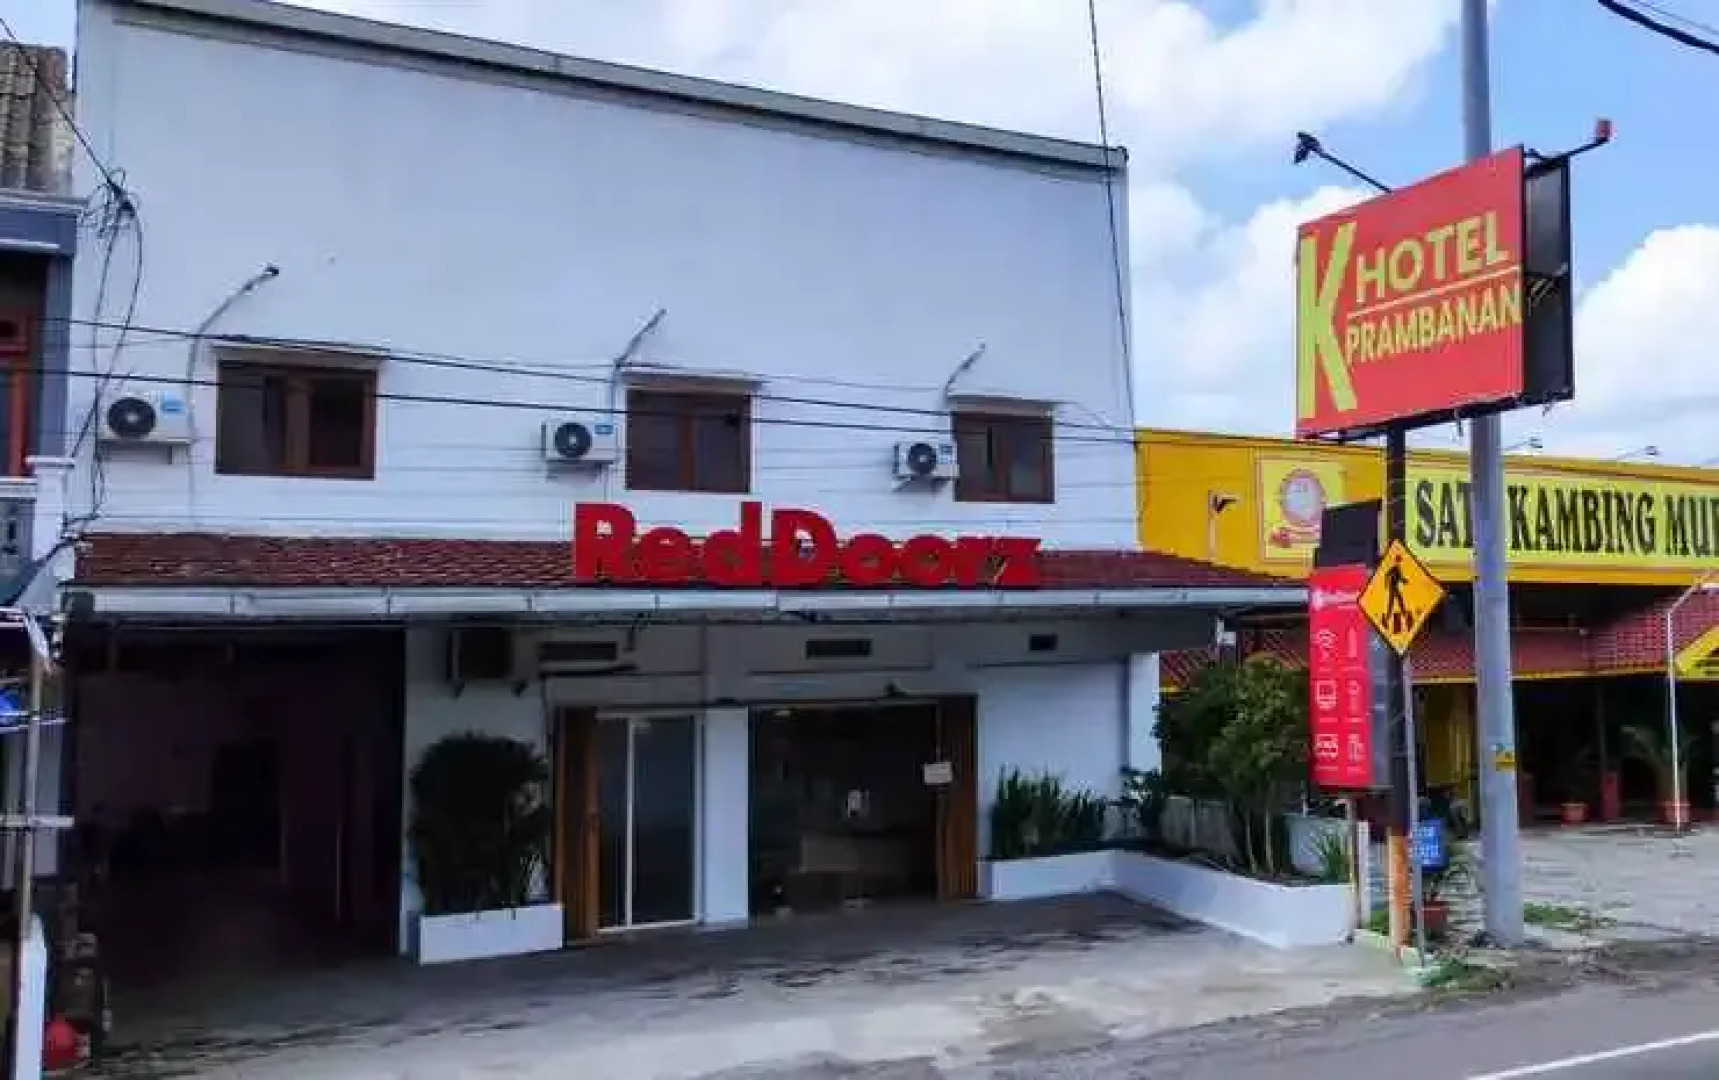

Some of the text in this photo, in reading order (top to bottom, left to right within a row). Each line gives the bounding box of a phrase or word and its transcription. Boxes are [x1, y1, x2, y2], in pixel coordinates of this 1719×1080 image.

[1299, 211, 1509, 419] K HOTEL
[1346, 282, 1523, 364] PRAMBANAN
[574, 502, 1042, 587] RedDoorz
[1416, 479, 1477, 549] SAT
[1508, 484, 1656, 556] KAMBING
